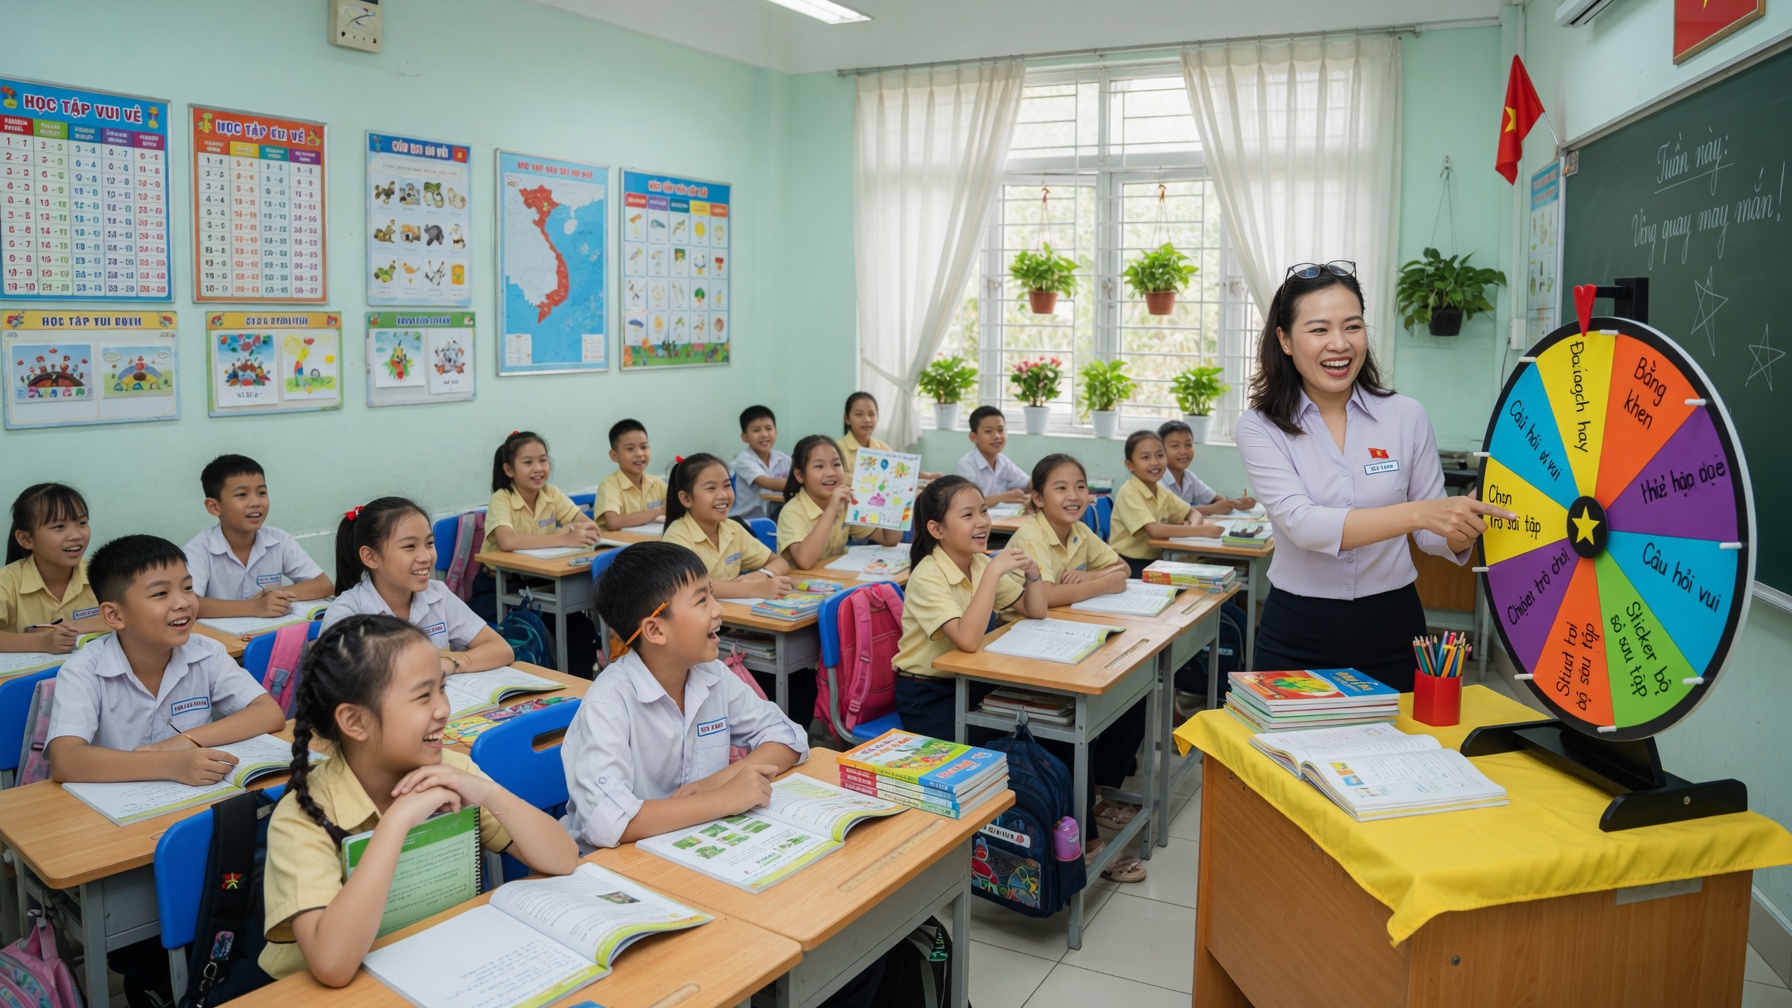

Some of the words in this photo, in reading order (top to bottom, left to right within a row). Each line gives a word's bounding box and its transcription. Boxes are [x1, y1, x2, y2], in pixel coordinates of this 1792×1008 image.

[24, 94, 57, 114] HỌC
[94, 104, 120, 121] VUI
[1656, 131, 1689, 184] Tuần
[1662, 214, 1692, 265] quay
[1698, 204, 1730, 260] may
[1633, 357, 1667, 406] Bằng
[1623, 389, 1653, 430] khen
[1574, 420, 1591, 453] hay
[1524, 514, 1541, 540] tập
[1642, 541, 1667, 576] Câu
[1671, 561, 1696, 594] hỏi
[1698, 586, 1722, 613] vui
[1626, 601, 1657, 662] Sticker
[1653, 666, 1672, 696] bộ
[1629, 665, 1648, 698] tập
